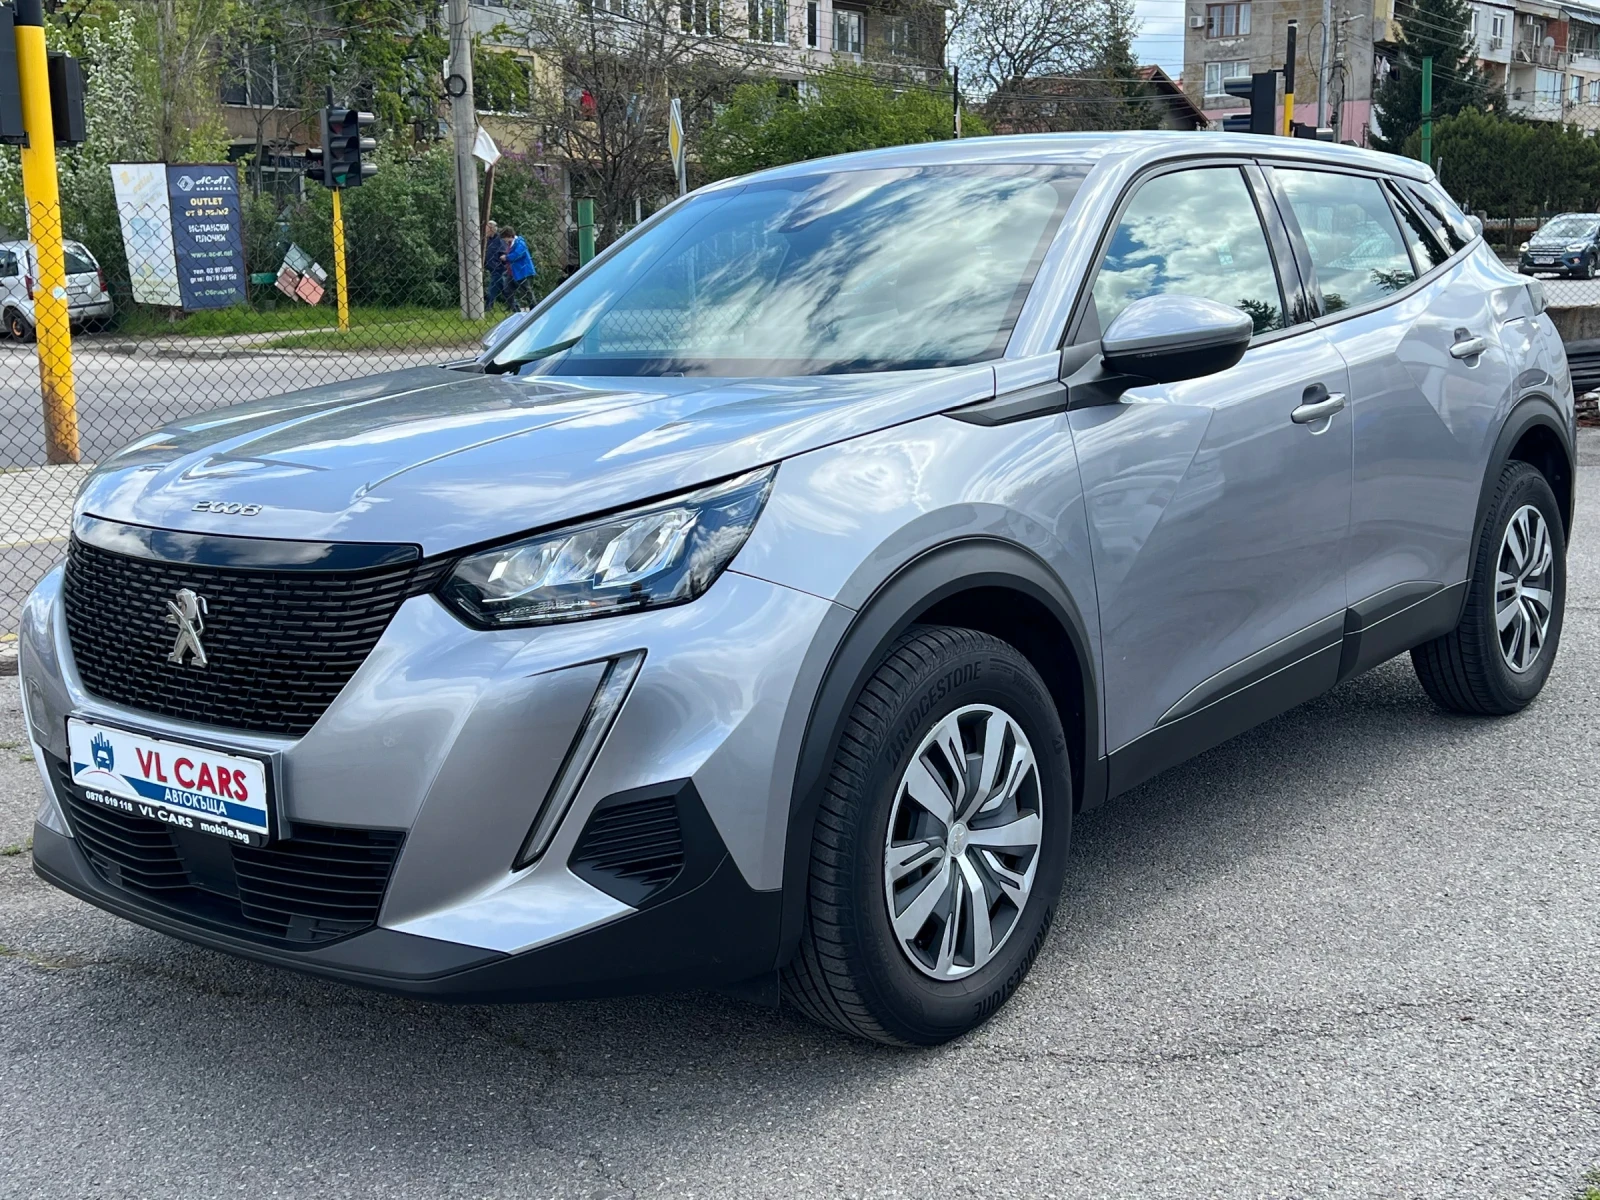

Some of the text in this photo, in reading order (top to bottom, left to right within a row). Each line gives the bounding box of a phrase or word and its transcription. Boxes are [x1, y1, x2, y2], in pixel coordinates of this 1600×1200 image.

[190, 197, 223, 206] OUTLET
[185, 209, 195, 217] от
[188, 223, 230, 233] ИСПАНСКИ
[195, 234, 226, 242] ПЛОЧКИ
[191, 500, 263, 516] 2008
[885, 660, 982, 772] BRIDGESTONE
[135, 747, 249, 802] VL CARS
[164, 787, 228, 816] АВТОКЪЩА
[104, 795, 118, 807] 619
[119, 799, 133, 812] 118
[139, 804, 155, 818] VL
[157, 810, 194, 829] CARS
[200, 821, 251, 844] mobile.bg
[973, 904, 1055, 1020] BRIDGESTONE
